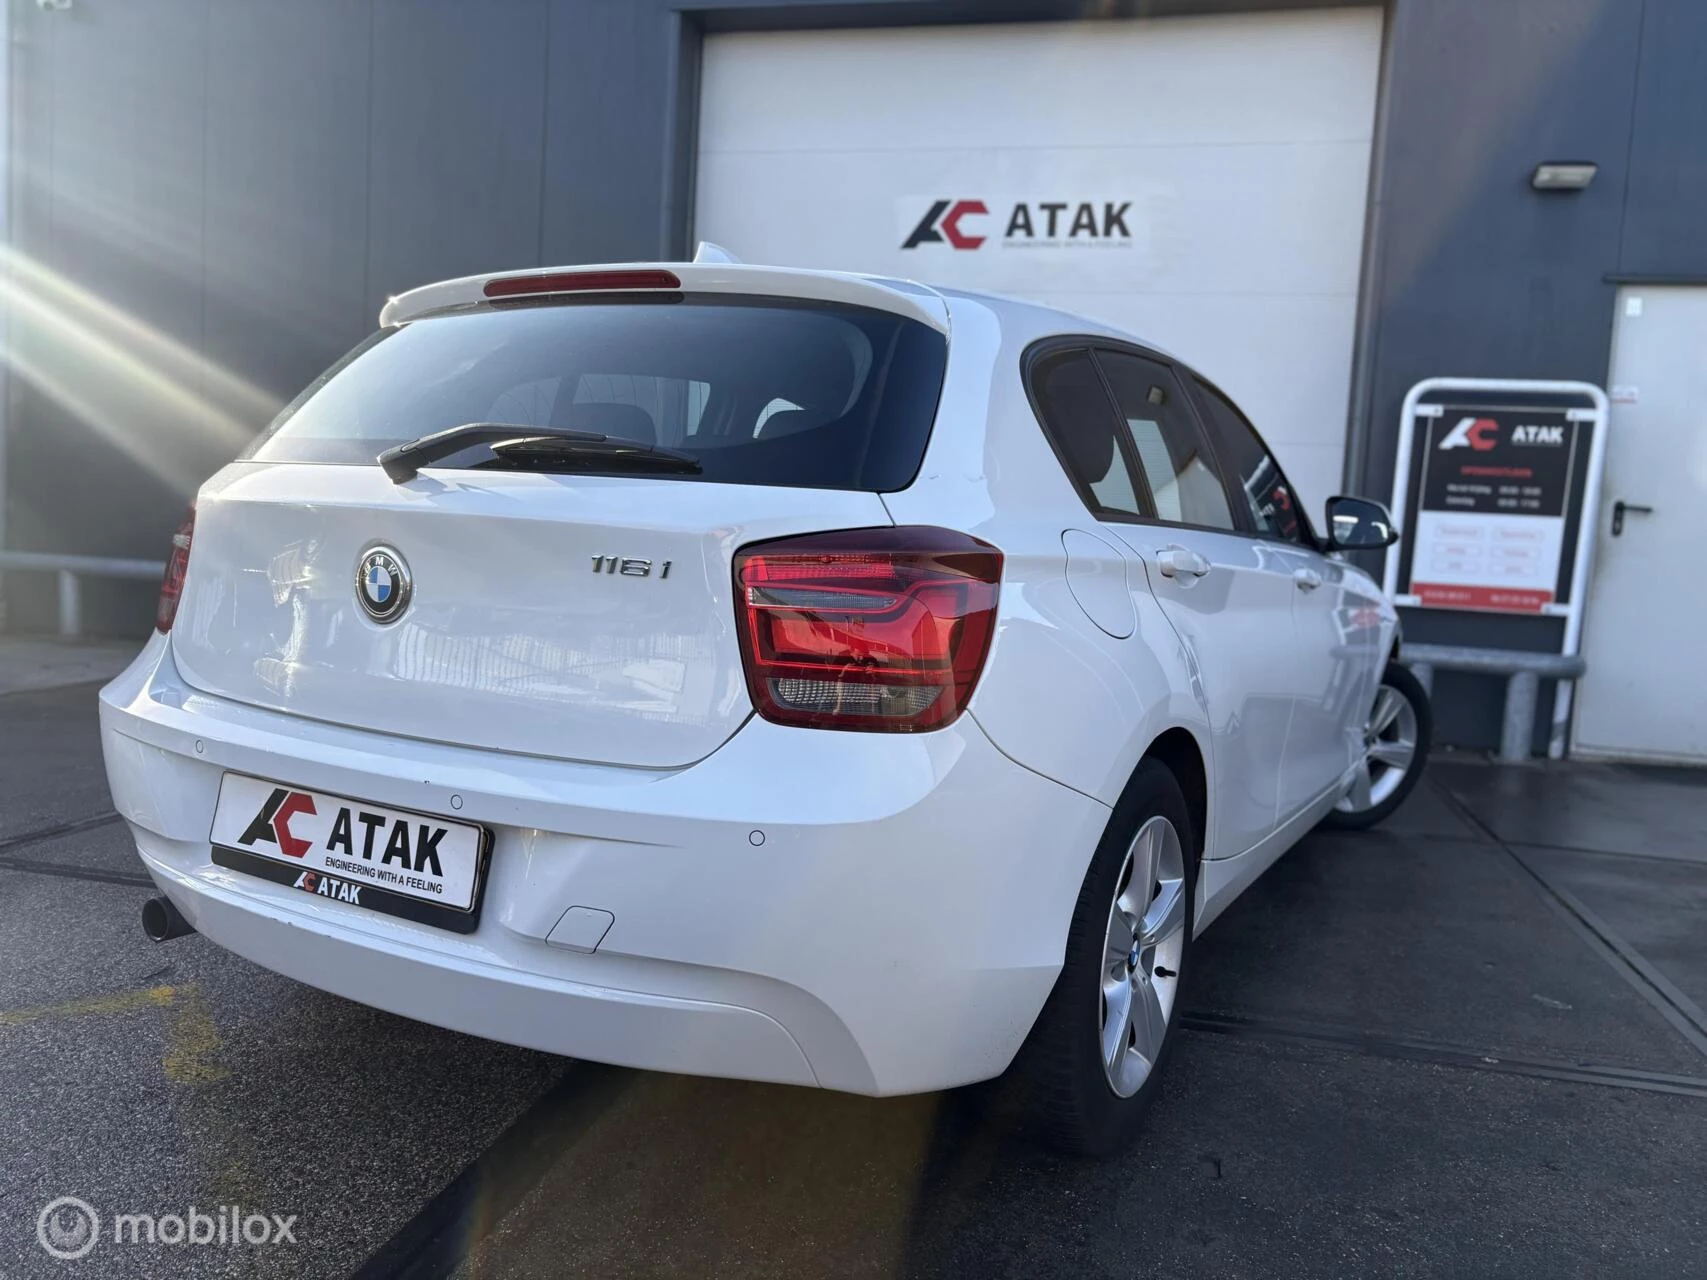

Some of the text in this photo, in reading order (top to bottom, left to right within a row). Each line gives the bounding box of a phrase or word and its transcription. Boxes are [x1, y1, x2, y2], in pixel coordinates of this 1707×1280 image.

[1005, 202, 1132, 238] ATAK
[1511, 425, 1564, 444] ATAK
[326, 807, 448, 877] ATAK
[317, 876, 362, 905] ATAK
[325, 856, 443, 894] ENGINEERING WITH A FEELING
